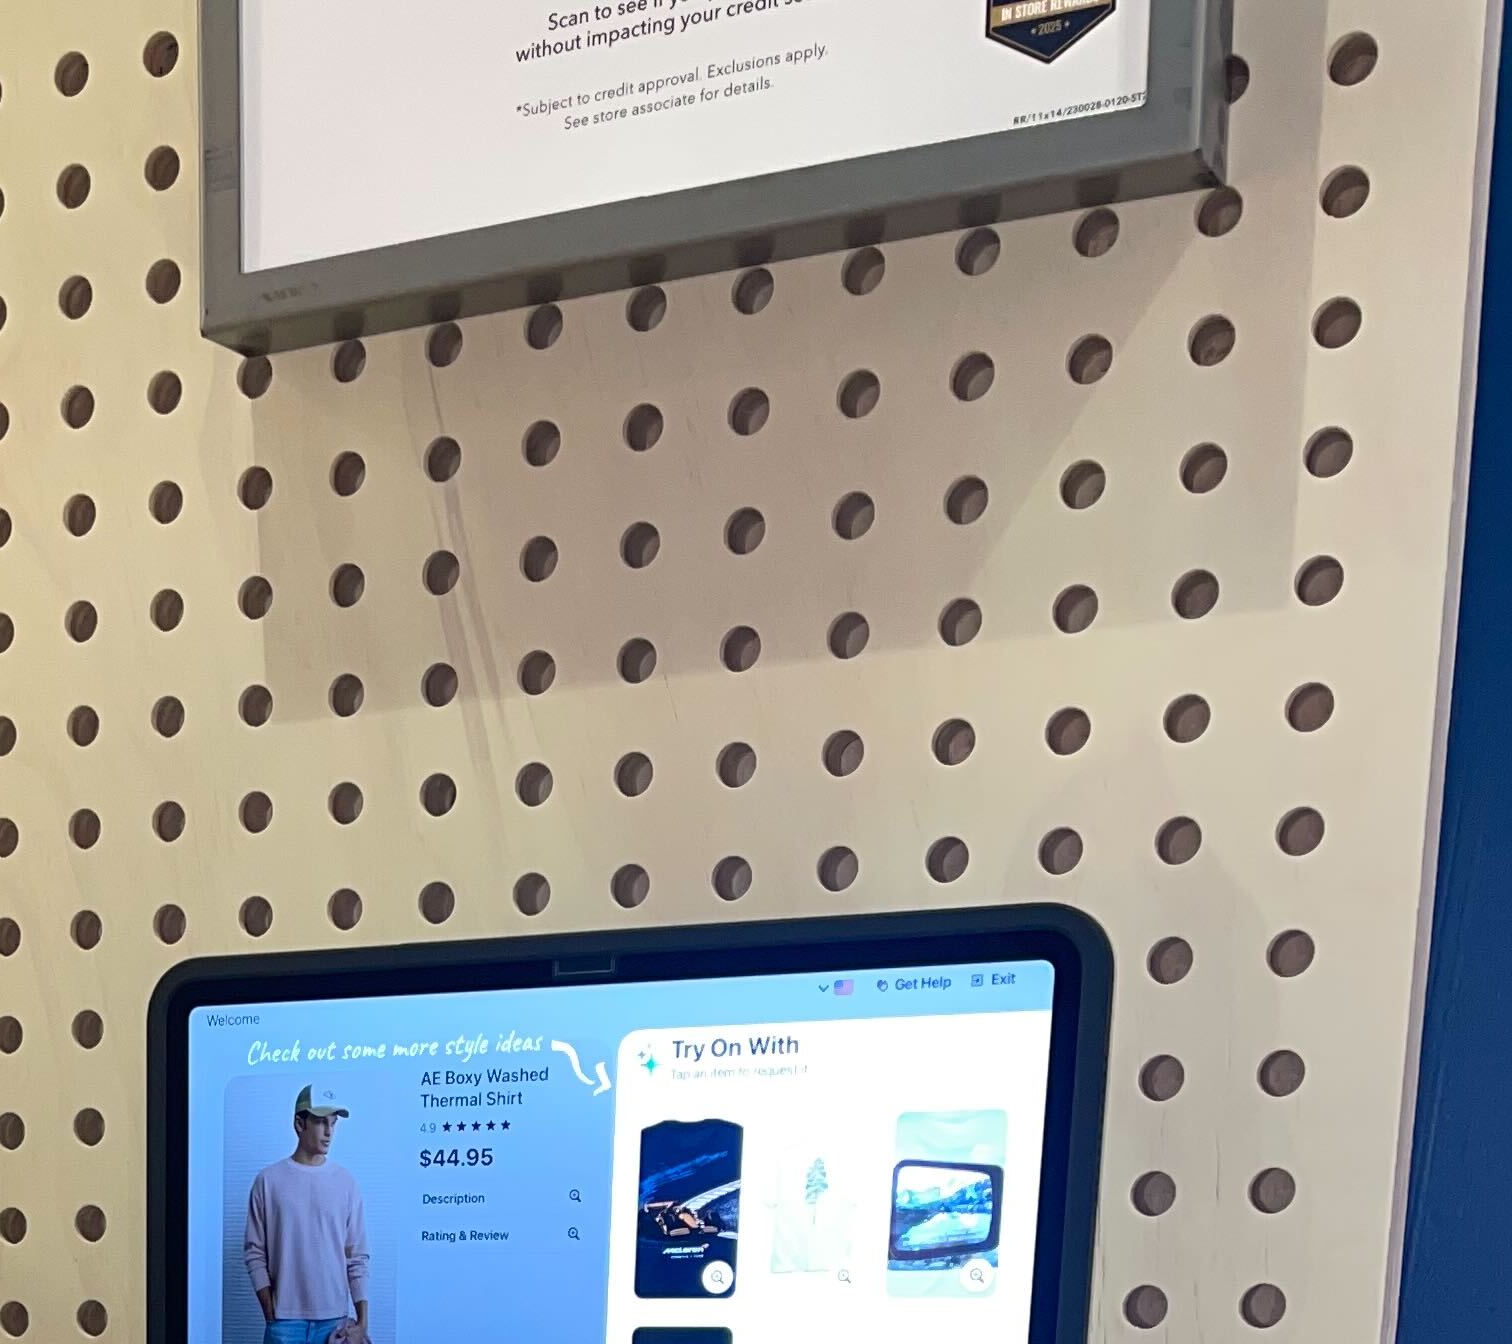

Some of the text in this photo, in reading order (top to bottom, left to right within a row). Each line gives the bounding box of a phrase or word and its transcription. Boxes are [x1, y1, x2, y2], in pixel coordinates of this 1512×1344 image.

[548, 10, 589, 31] Scan
[594, 5, 612, 20] to
[617, 0, 648, 16] see
[516, 35, 582, 62] without
[587, 17, 675, 48] impacting
[680, 6, 721, 32] your
[577, 93, 591, 106] to
[594, 81, 634, 102] credit
[638, 66, 702, 95] approval.
[707, 59, 781, 79] Exclusions
[564, 115, 589, 130] See
[593, 106, 628, 124] store
[631, 92, 696, 116] associate
[700, 87, 719, 103] for
[895, 975, 952, 991] Get Help
[991, 973, 1016, 985] Exit
[206, 1014, 260, 1027] Welcome
[247, 1030, 544, 1066] Check out some more style ideas
[672, 1035, 799, 1063] Try On With
[420, 1066, 549, 1087] AE Boxy Washed
[420, 1090, 523, 1109] Thermal Shirt
[419, 1148, 494, 1169] $44.95
[422, 1193, 486, 1206] Description
[421, 1229, 509, 1243] Rating & Review
